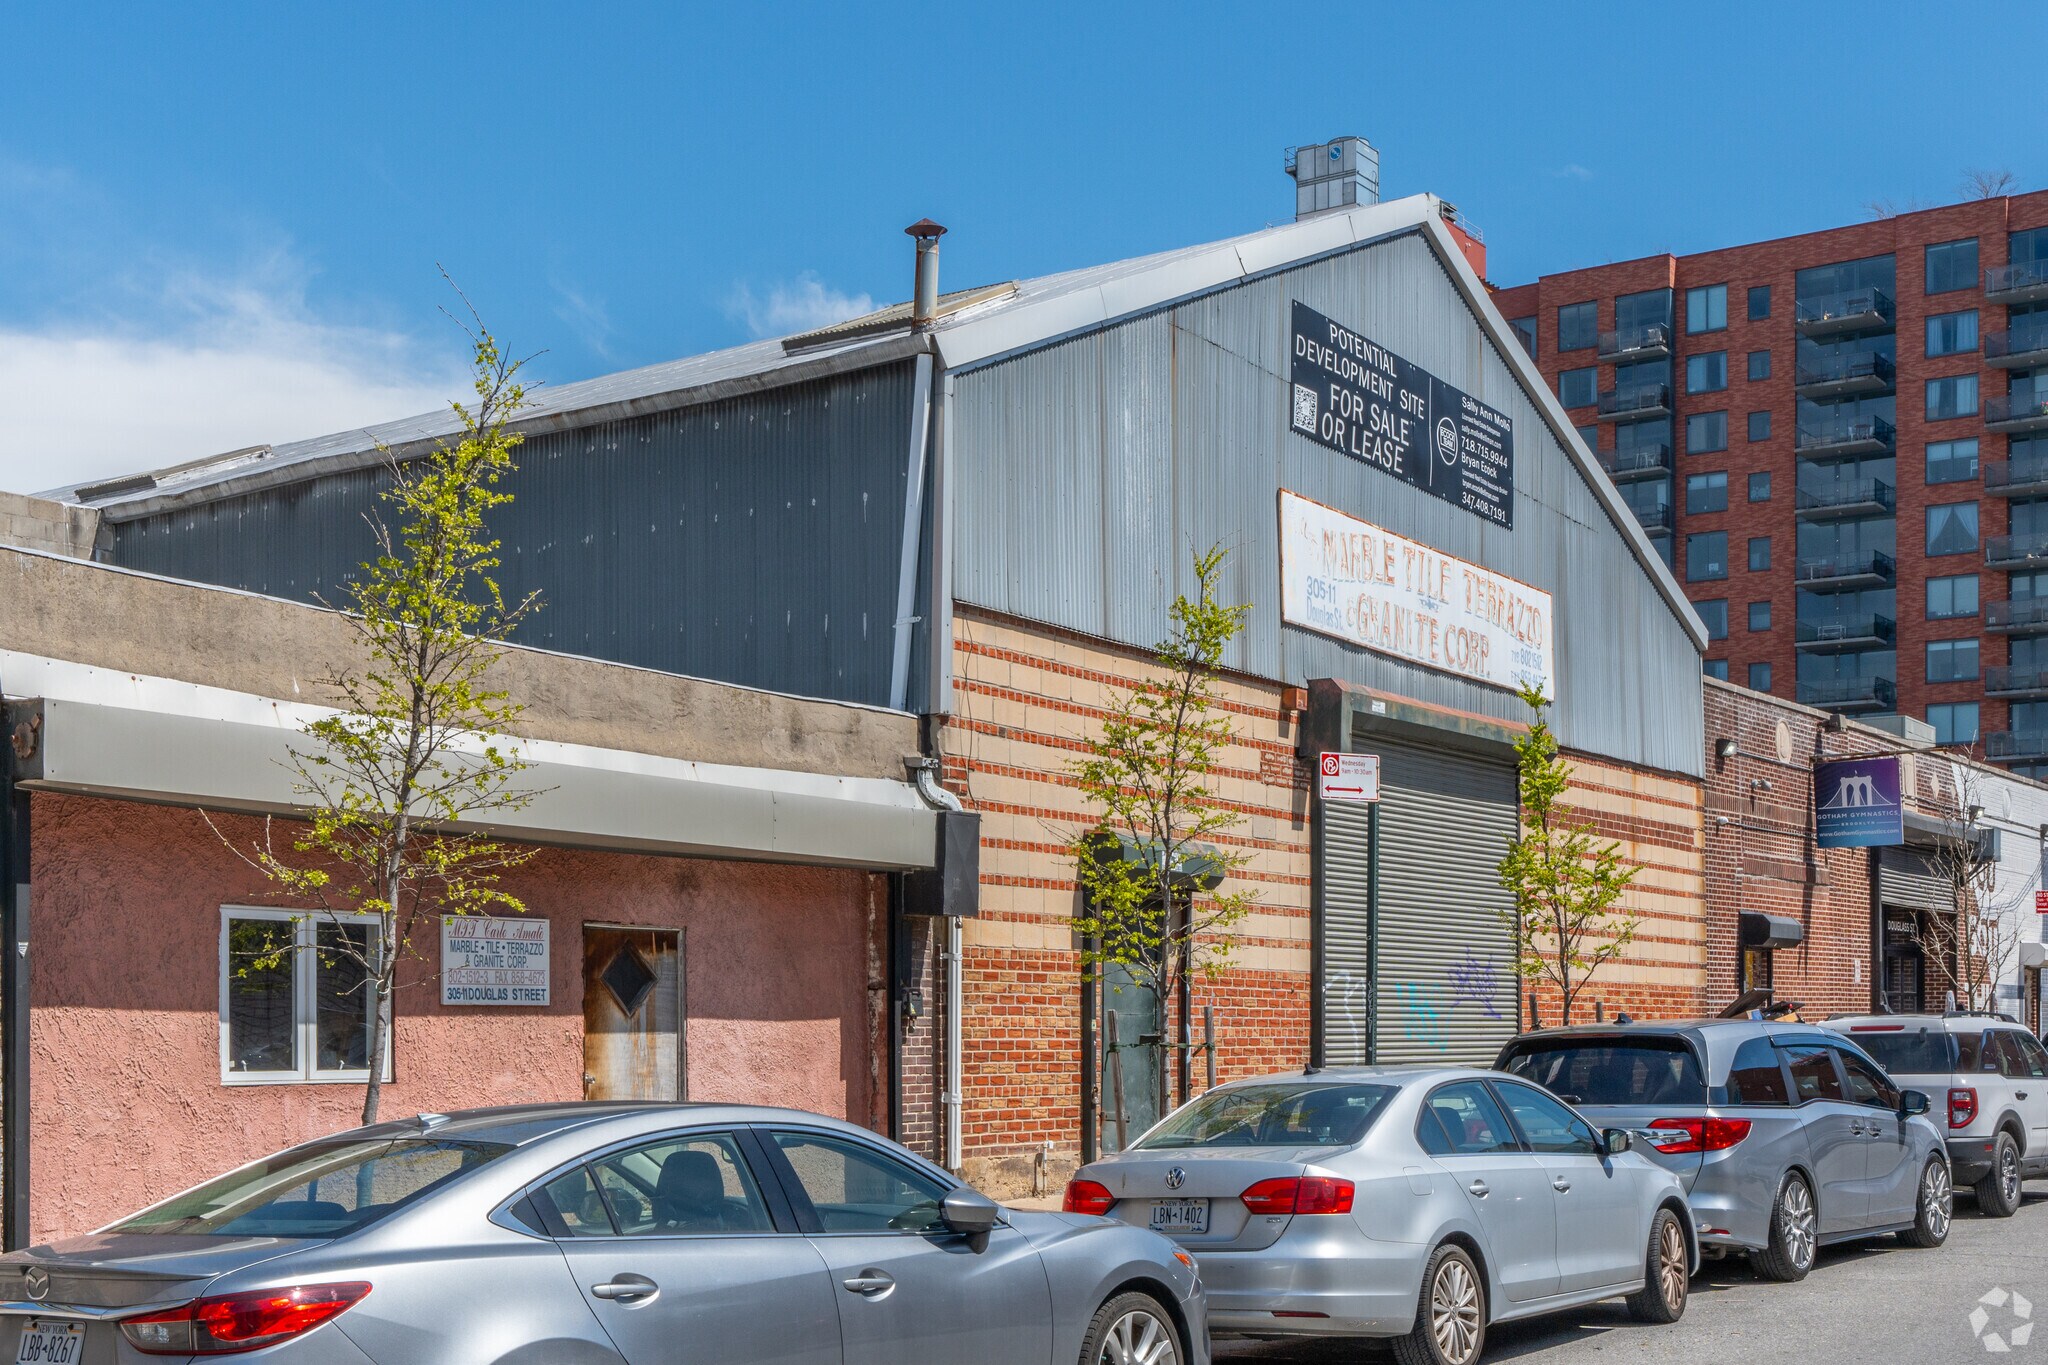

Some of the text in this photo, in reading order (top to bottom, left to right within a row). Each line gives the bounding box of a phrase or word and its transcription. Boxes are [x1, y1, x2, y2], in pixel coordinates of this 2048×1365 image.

[1329, 323, 1397, 378] POTENTIAL
[1296, 333, 1425, 420] DEVELOPMENT SITE
[1330, 383, 1409, 446] FOR SALE
[1461, 396, 1511, 432] Sally Ann Mollo
[1321, 412, 1404, 473] OR LEASE
[1461, 435, 1508, 469] 718.715.9944
[1461, 451, 1480, 471] Bryan
[1480, 460, 1497, 479] Ecock
[1461, 491, 1506, 522] 347.408.7191
[1306, 575, 1336, 605] 305-11
[1322, 527, 1396, 588] MARBLE
[1403, 544, 1451, 605] TILE
[1463, 568, 1543, 650] TERRAZZO
[1306, 596, 1334, 629] Douglas
[1357, 592, 1439, 664] GRANITE
[1850, 810, 1899, 818] GYMNASTICS
[1819, 828, 1900, 838] www.GothamGymnastics.com
[483, 919, 507, 938] Carlo
[512, 922, 544, 940] Amati
[450, 940, 544, 955] MARBLE TILE TERRAZZO
[465, 954, 528, 968] & GRANITE CORP.
[448, 970, 545, 984] 802-1512-3 FAX 858-4673
[468, 987, 508, 1001] DOUGLAS
[512, 988, 547, 1001] STREET
[37, 1324, 68, 1335] NEW YORK
